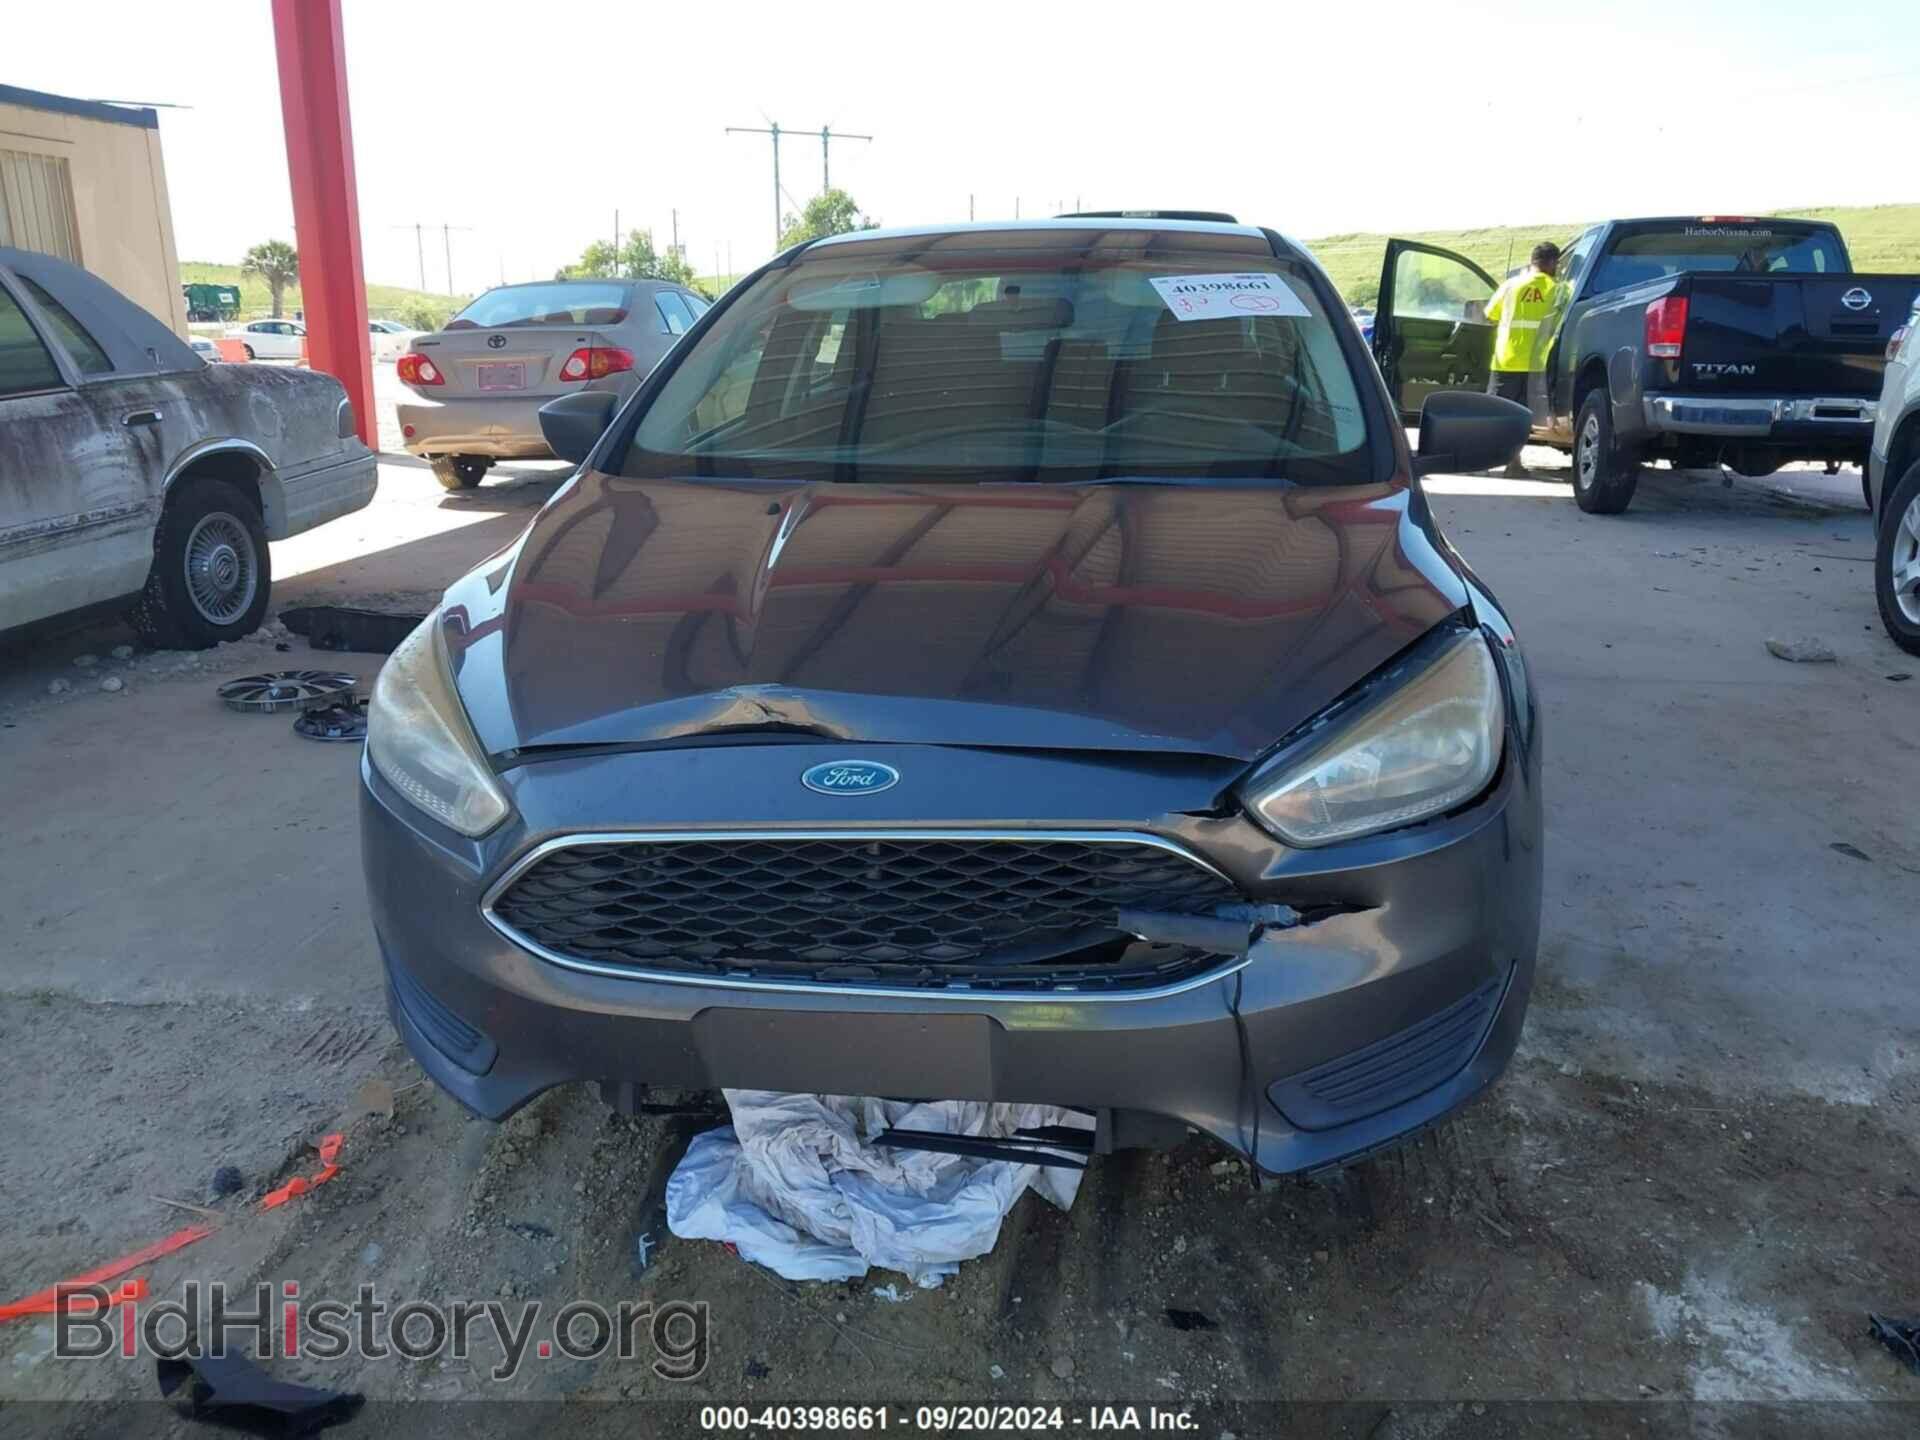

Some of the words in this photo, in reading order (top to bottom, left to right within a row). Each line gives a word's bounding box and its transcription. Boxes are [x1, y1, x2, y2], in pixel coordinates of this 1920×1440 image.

[1171, 280, 1273, 294] 40398661
[1692, 362, 1757, 375] TITAN
[823, 766, 877, 787] Ford
